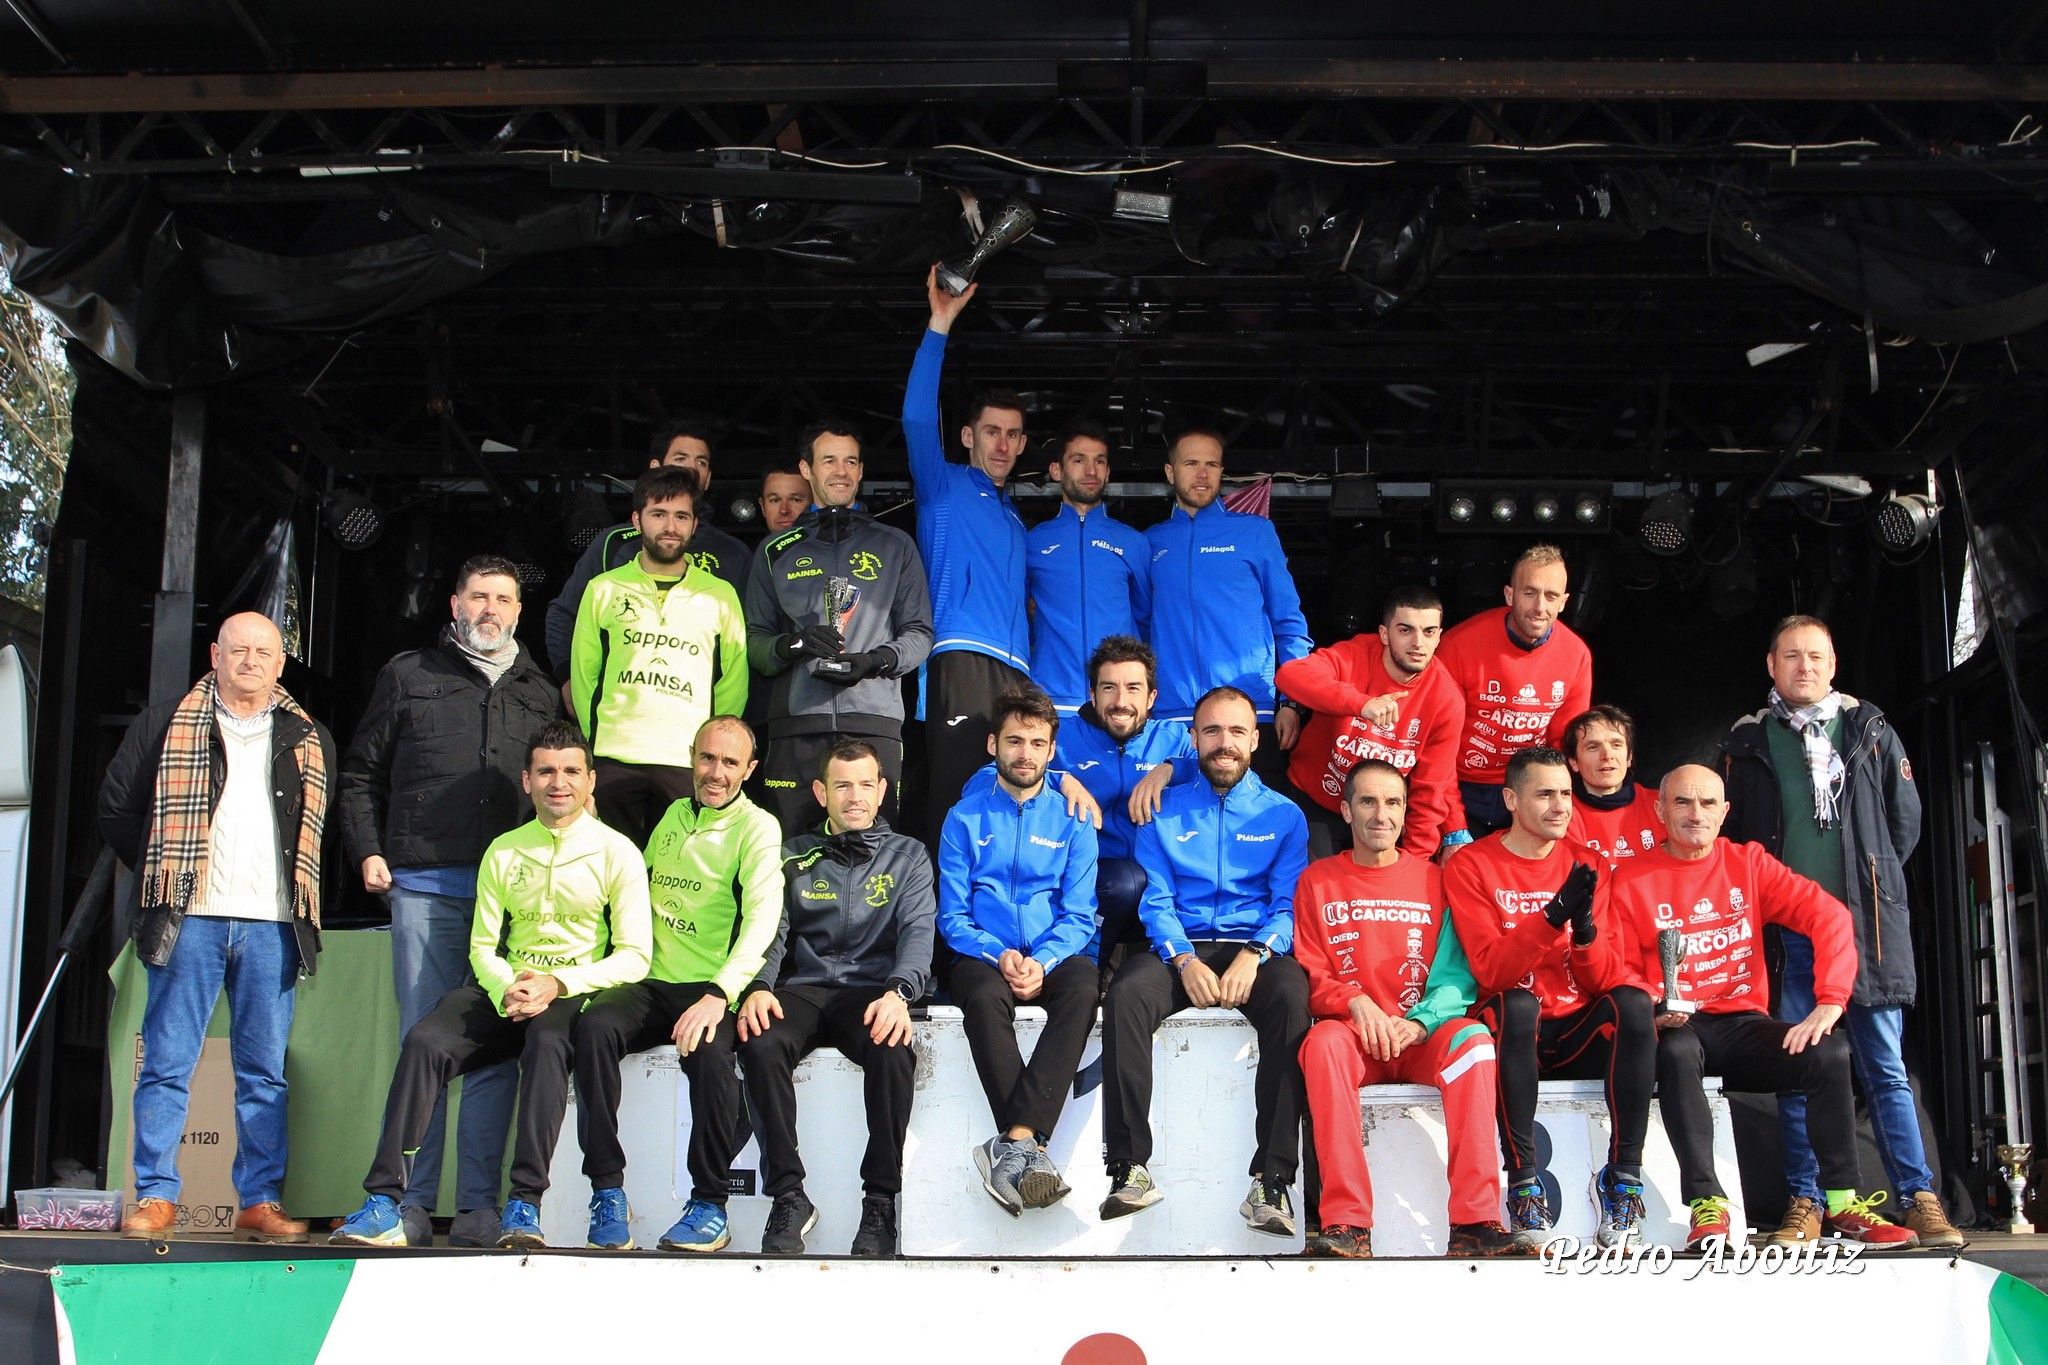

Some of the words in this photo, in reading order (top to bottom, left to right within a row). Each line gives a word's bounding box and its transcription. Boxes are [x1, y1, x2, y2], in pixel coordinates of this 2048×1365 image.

[787, 568, 824, 580] MAINSA
[623, 628, 699, 656] Sapporo
[617, 670, 693, 697] MAINSA
[1478, 708, 1551, 730] CÁRCOB
[1502, 733, 1533, 743] LOREDO
[652, 871, 702, 892] Sapporo
[801, 890, 838, 900] MAINSA
[1350, 899, 1432, 911] CONSTRUCCIONES
[518, 908, 580, 927] Sapporo
[1351, 908, 1432, 925] CARCOBA
[515, 949, 578, 967] MAINSA
[1694, 955, 1727, 973] LOREDO
[191, 1131, 220, 1145] 1120
